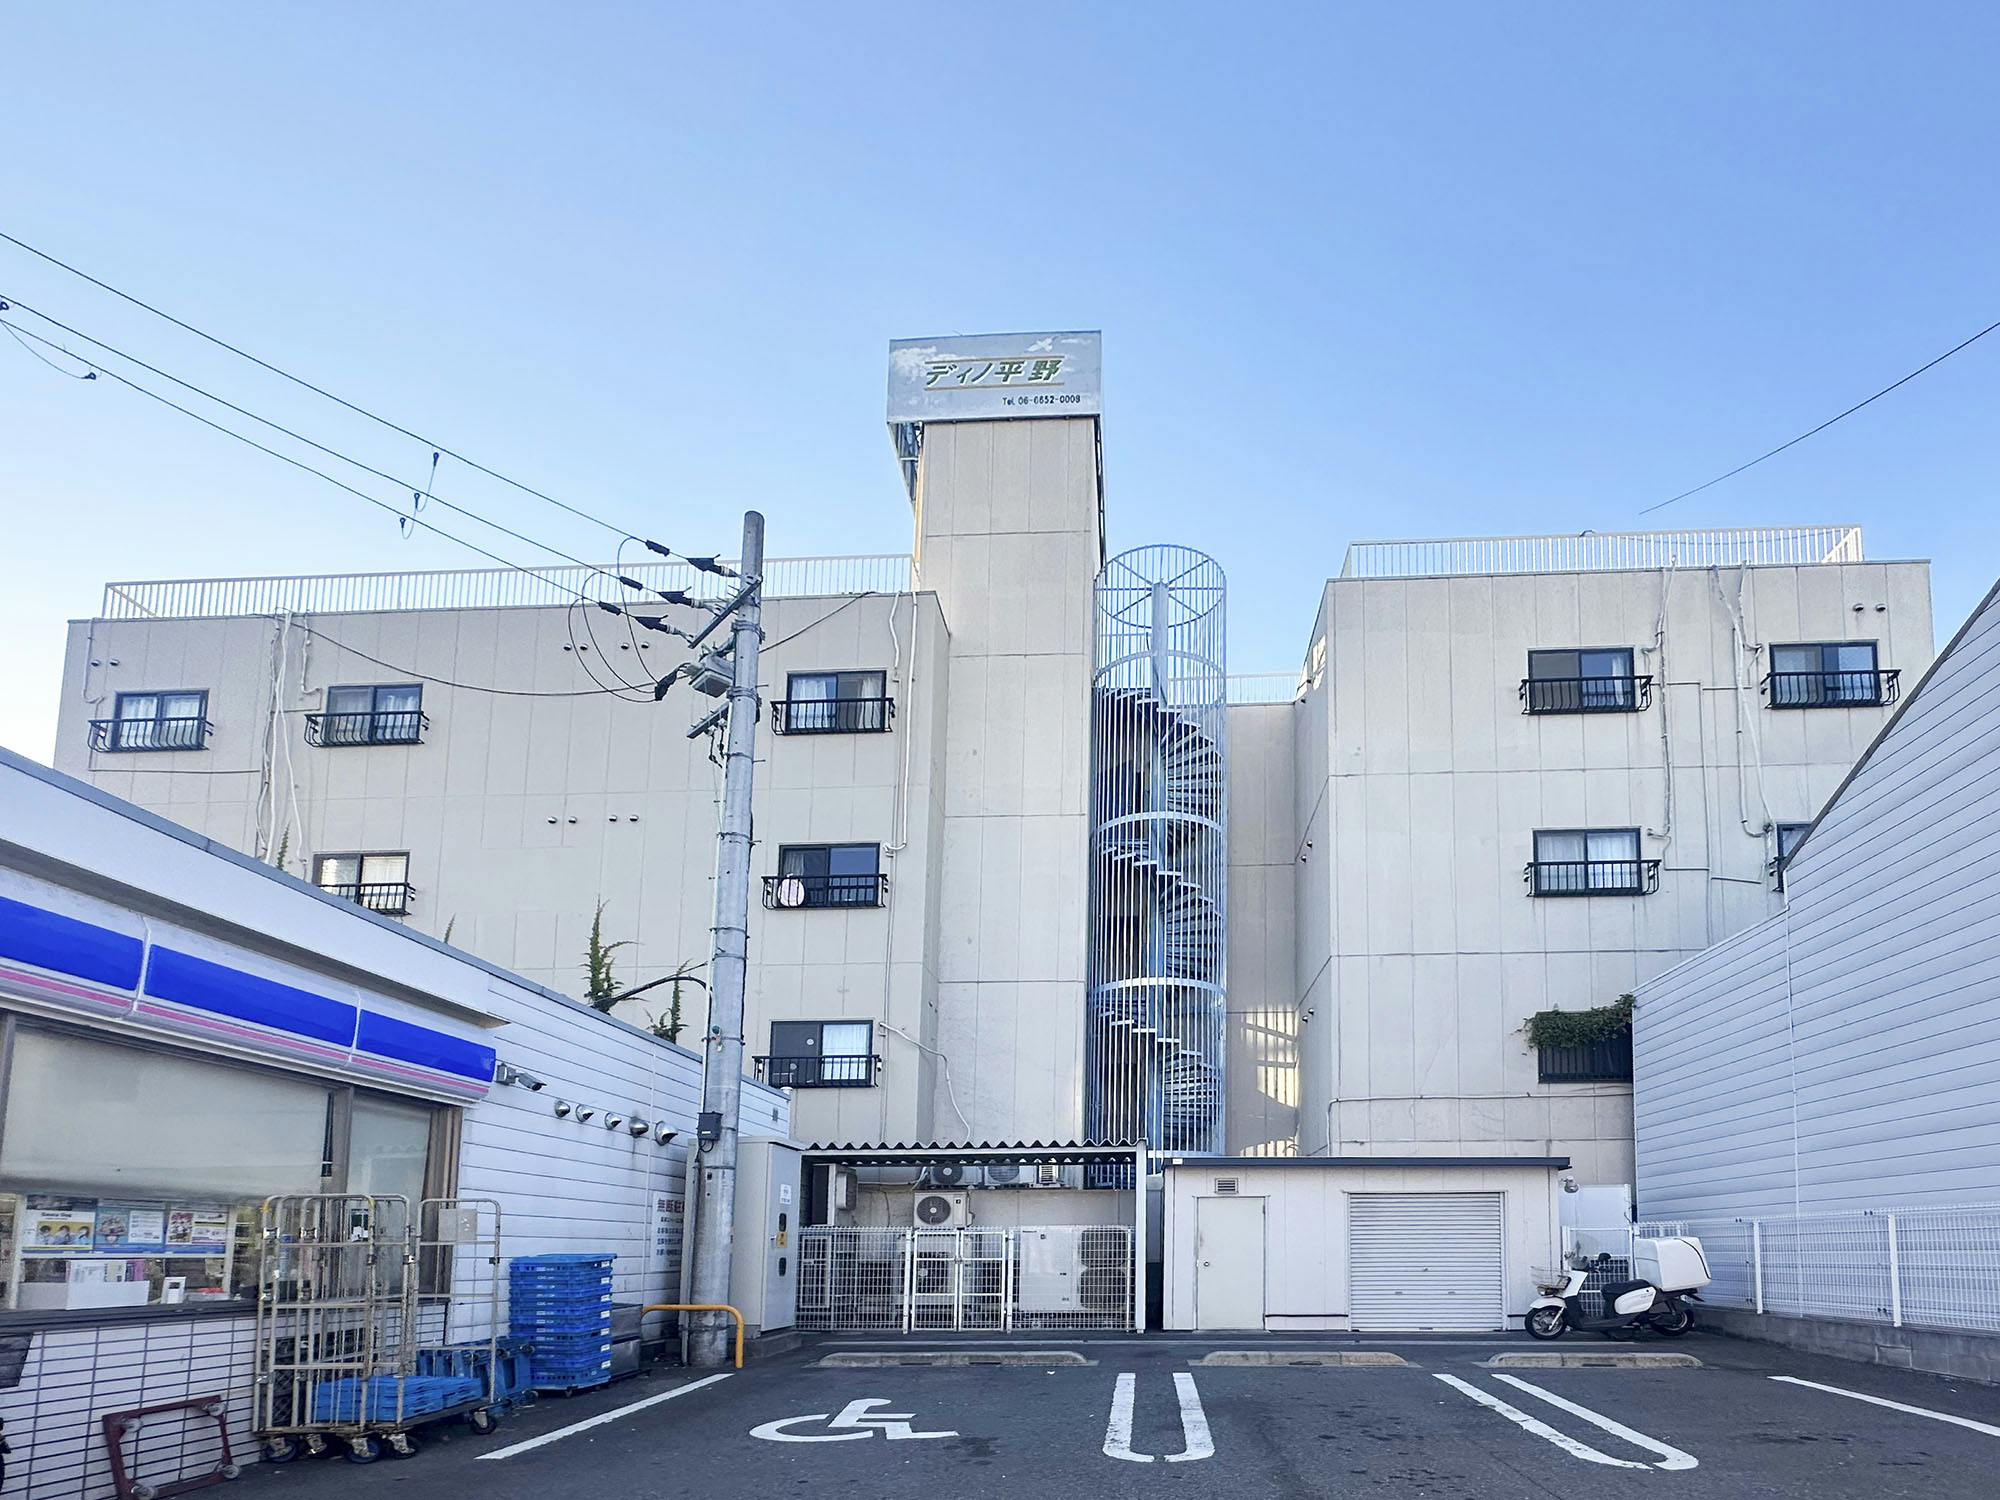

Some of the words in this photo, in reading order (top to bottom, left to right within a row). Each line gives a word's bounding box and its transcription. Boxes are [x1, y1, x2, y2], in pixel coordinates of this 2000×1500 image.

[926, 359, 1063, 386] ディノ平野
[657, 1198, 685, 1214] 無断駐
